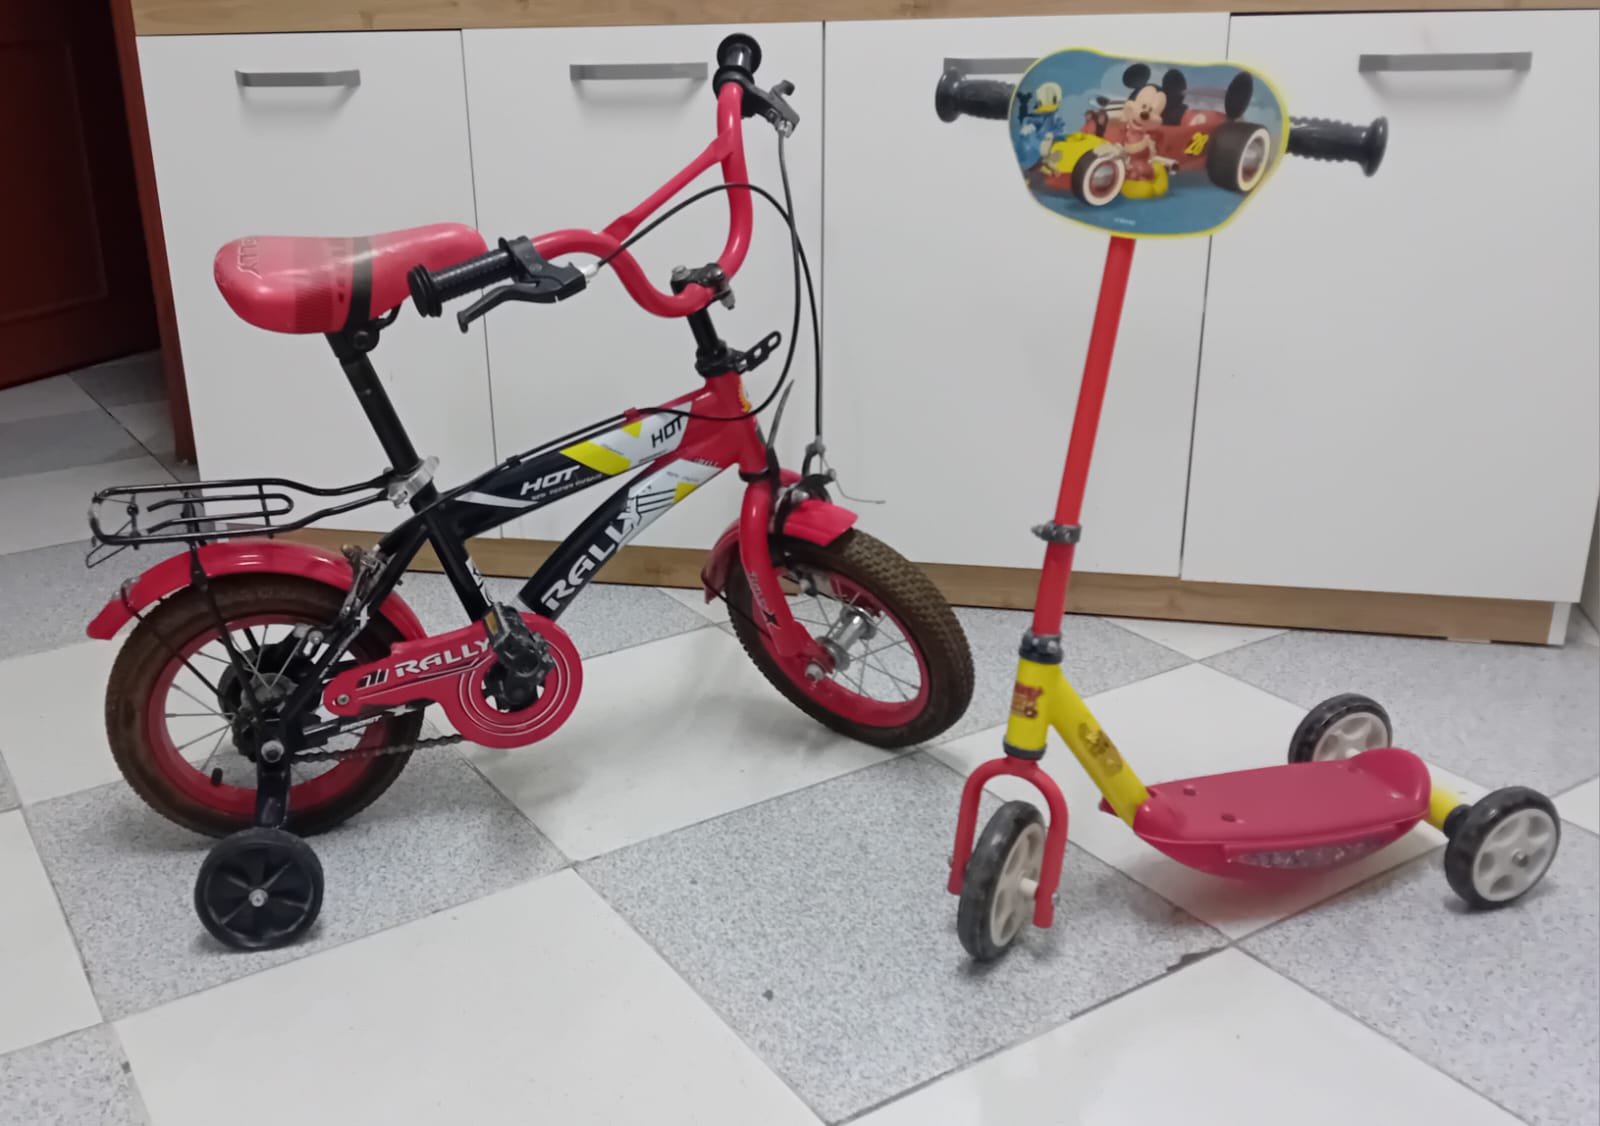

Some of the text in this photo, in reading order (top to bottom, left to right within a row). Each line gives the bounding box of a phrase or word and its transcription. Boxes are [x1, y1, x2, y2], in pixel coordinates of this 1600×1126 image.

[652, 414, 684, 447] HOT
[521, 465, 580, 496] HOT
[541, 495, 640, 611] RALLY
[394, 638, 490, 677] RALLY
